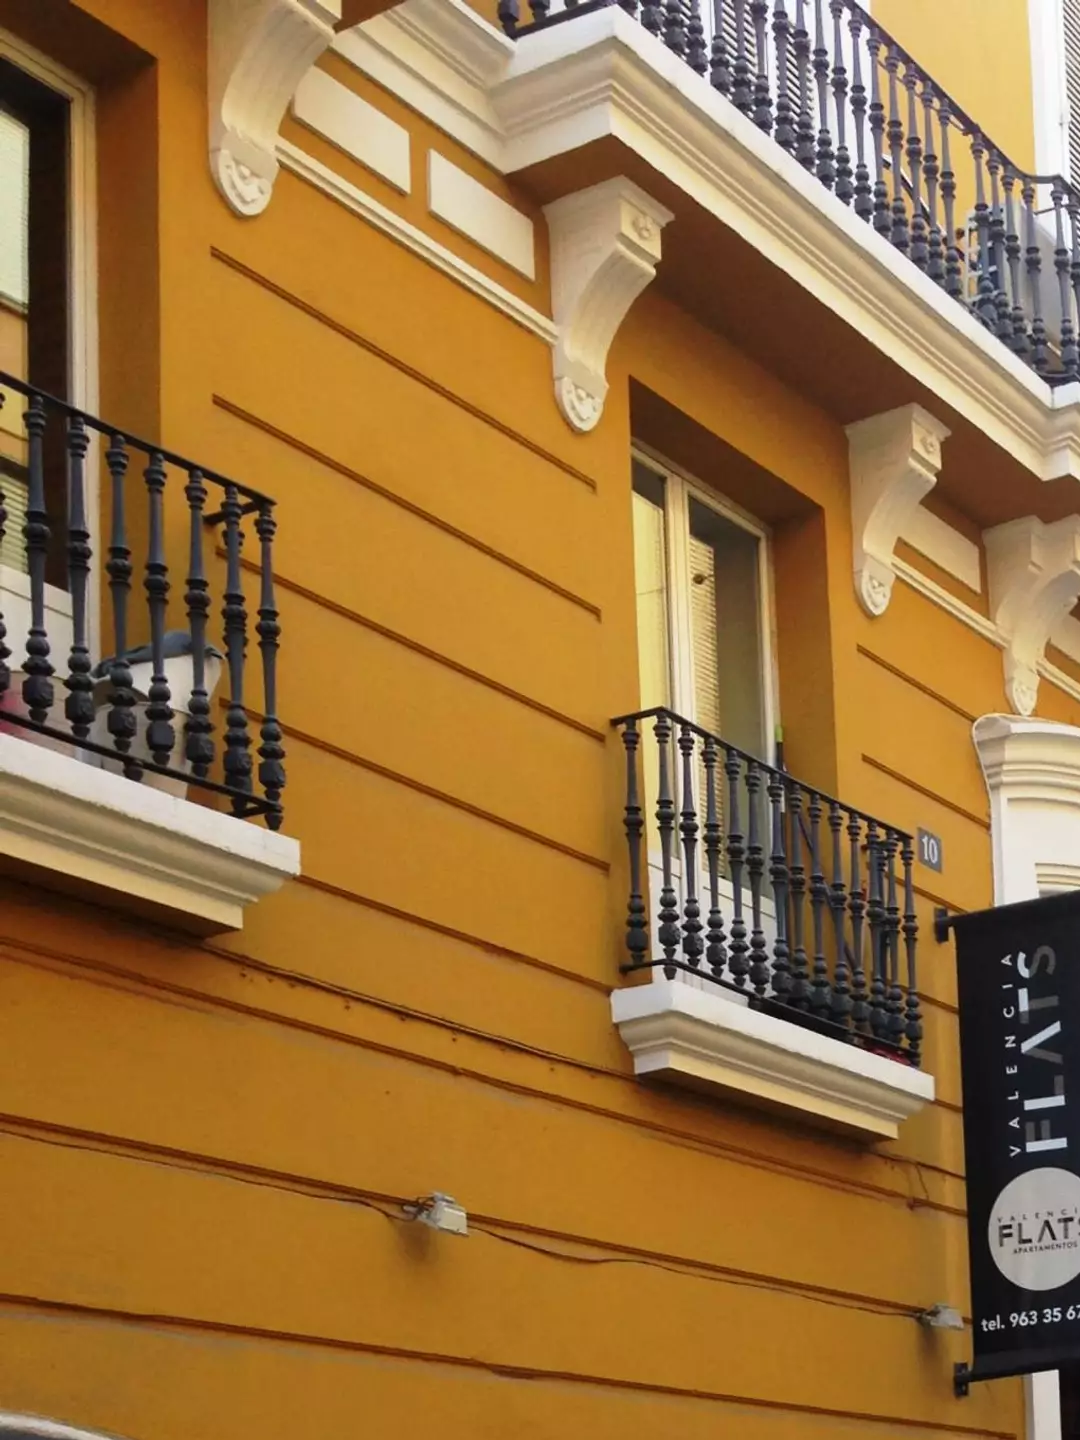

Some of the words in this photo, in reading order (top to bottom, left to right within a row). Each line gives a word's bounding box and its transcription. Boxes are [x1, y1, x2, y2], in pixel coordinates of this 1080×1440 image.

[922, 835, 938, 863] 10
[1000, 954, 1022, 1157] VALENCIA
[1016, 945, 1068, 1153] FLATS
[1013, 1241, 1078, 1255] APARTAMENTOS
[981, 1314, 1005, 1332] tel.
[1009, 1311, 1038, 1327] 963
[1042, 1307, 1062, 1323] 35
